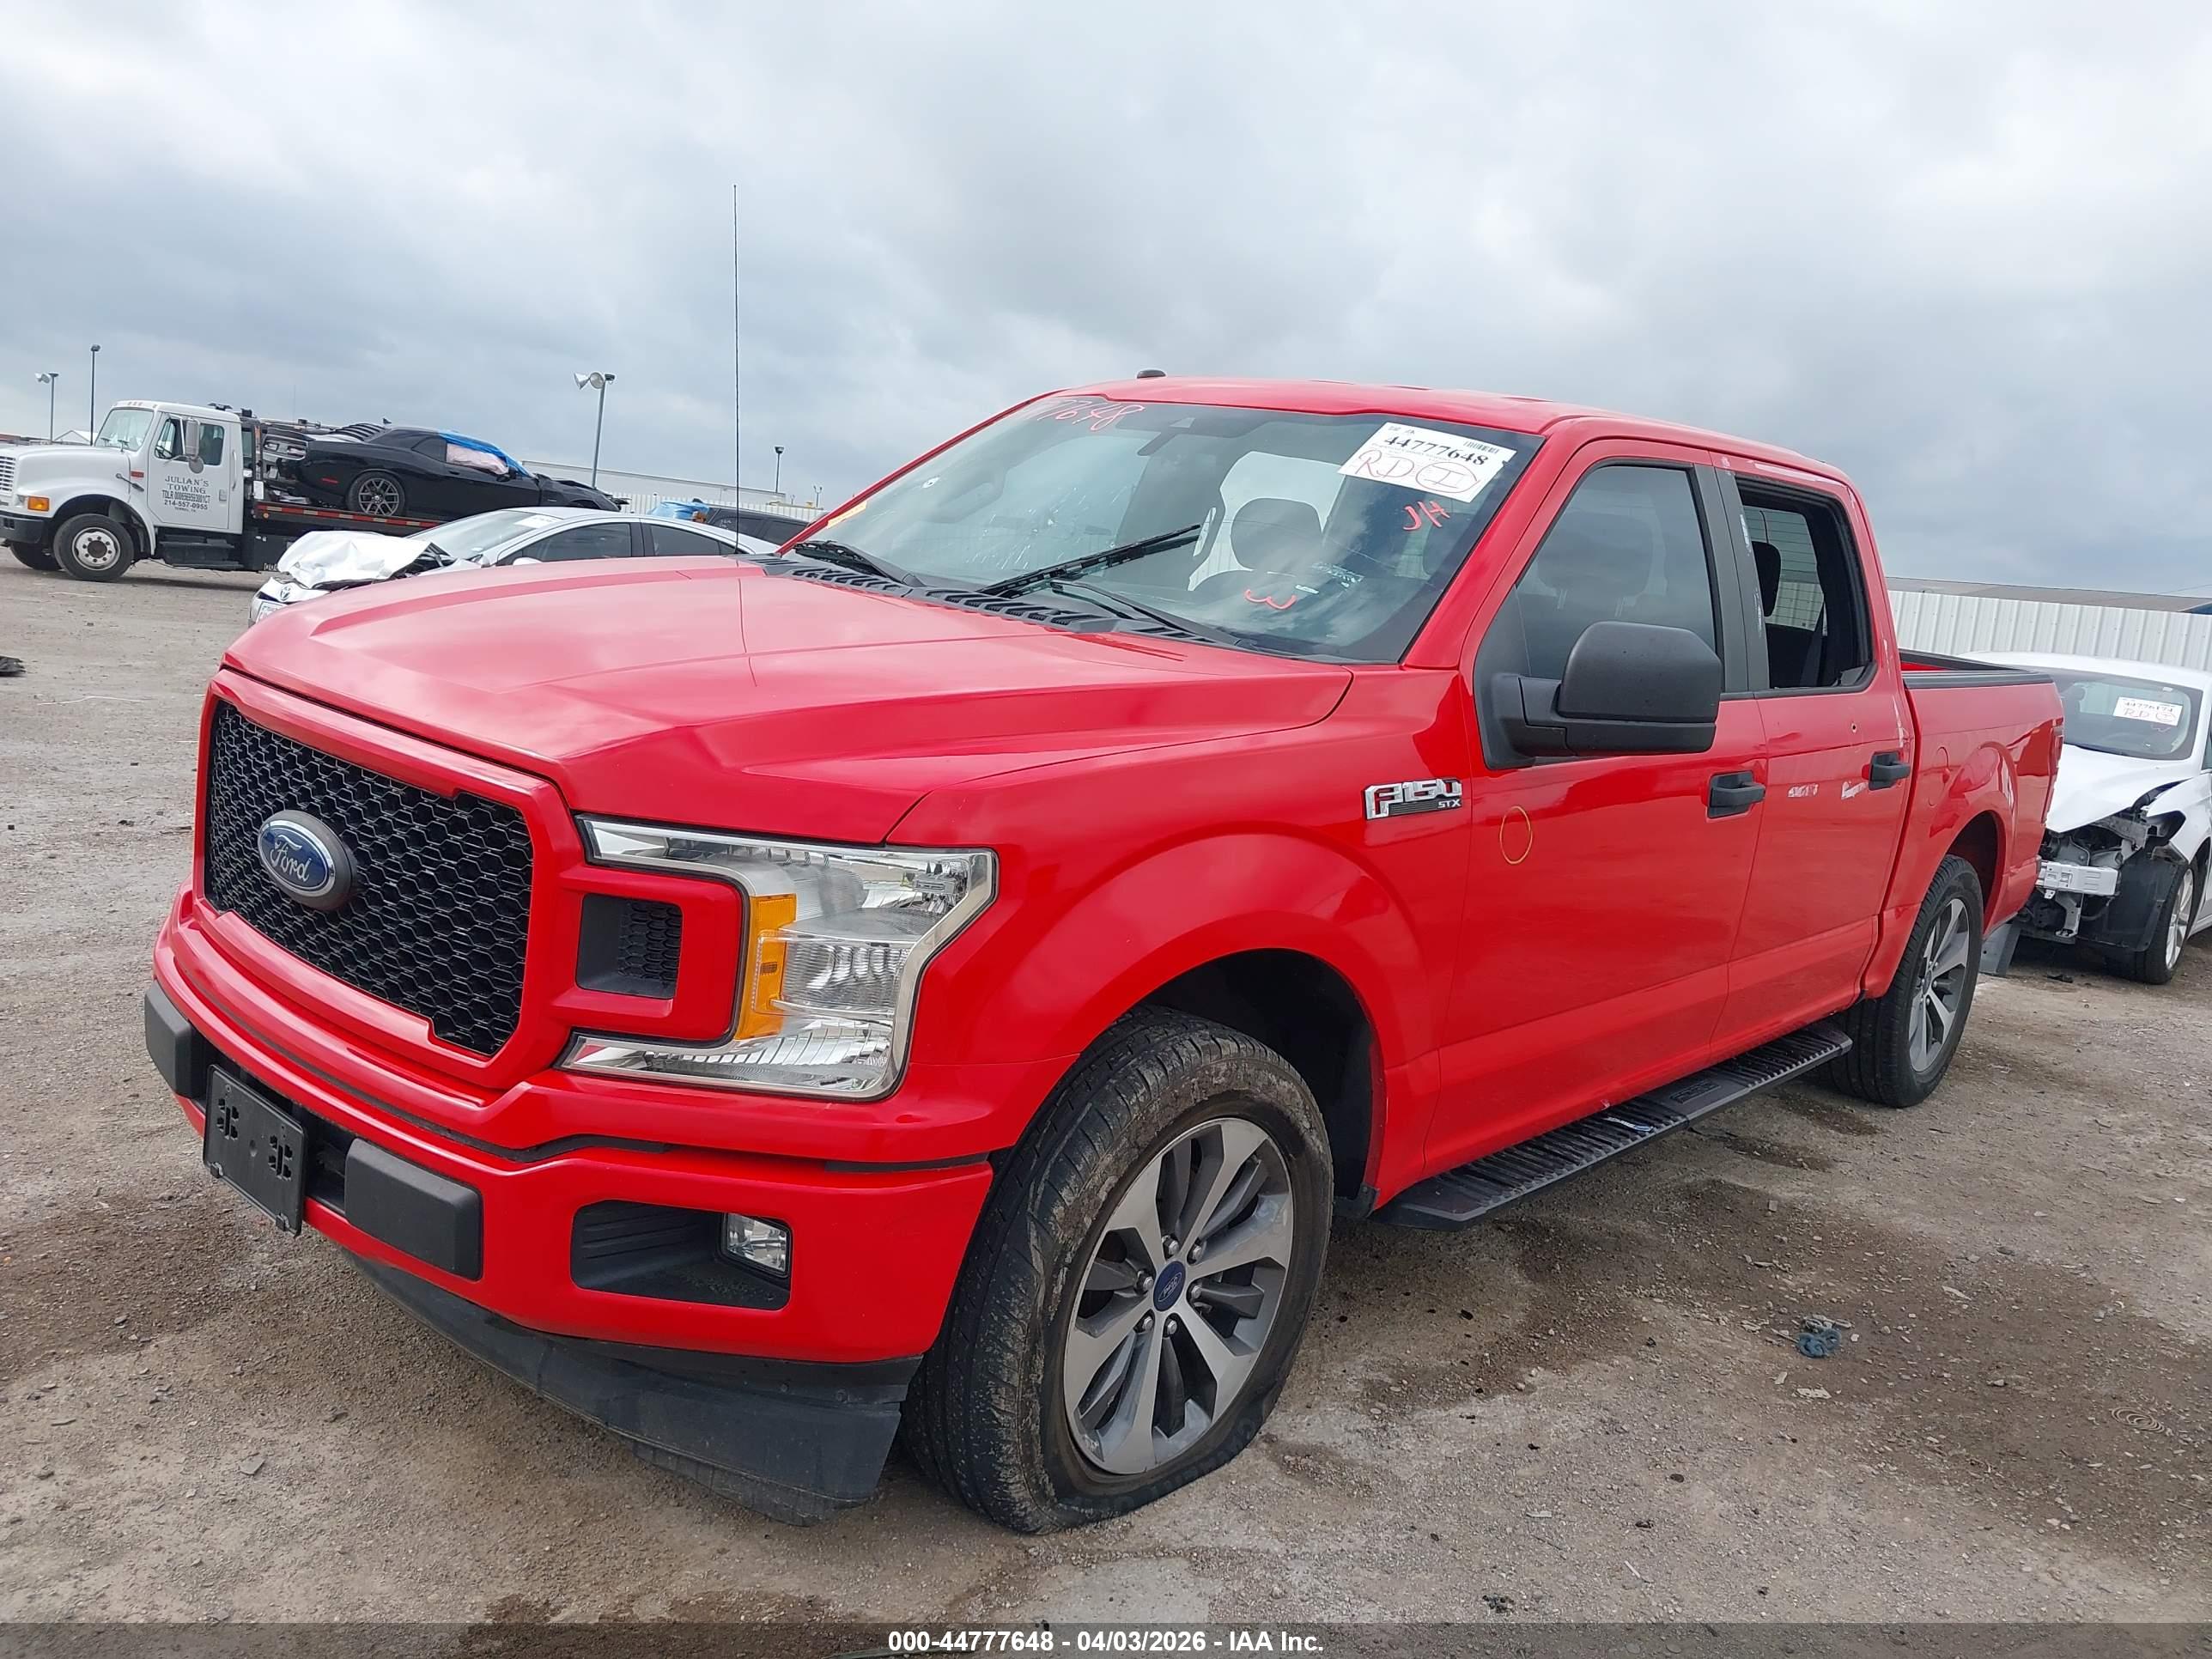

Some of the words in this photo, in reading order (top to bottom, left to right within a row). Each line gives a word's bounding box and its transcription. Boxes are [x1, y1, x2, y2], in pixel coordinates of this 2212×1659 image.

[1384, 436, 1489, 466] 44777648
[165, 476, 209, 487] JULIAN'S
[167, 483, 206, 494] TOWING
[164, 499, 208, 510] 214-557-0955
[1437, 799, 1462, 809] STX
[270, 834, 313, 883] Ford
